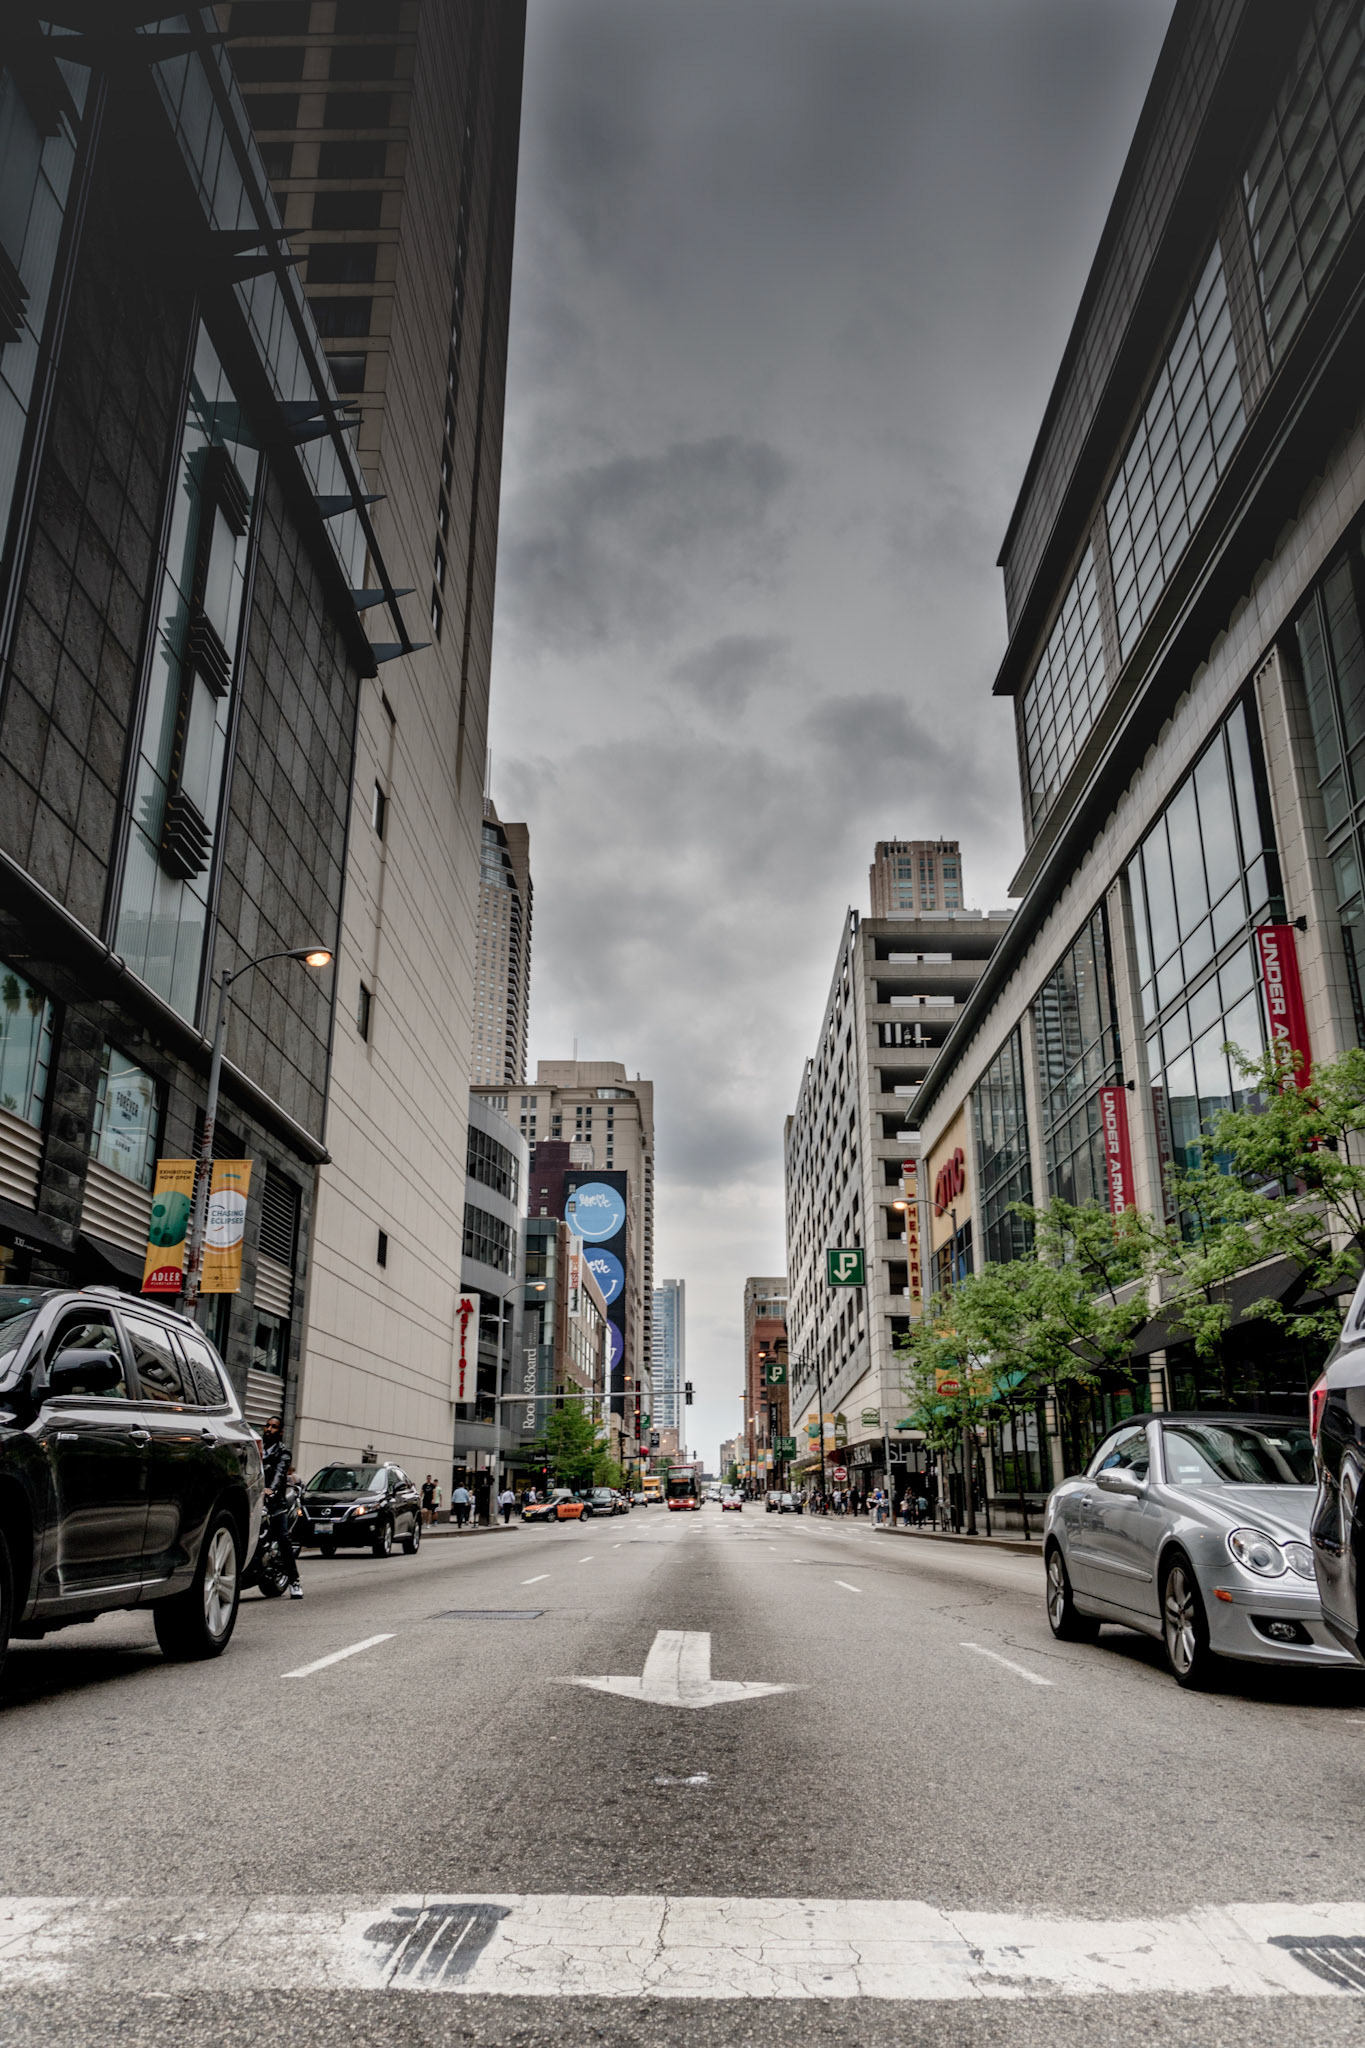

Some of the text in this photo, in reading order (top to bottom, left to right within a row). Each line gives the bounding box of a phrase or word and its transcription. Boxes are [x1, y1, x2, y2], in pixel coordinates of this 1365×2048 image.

[1261, 932, 1287, 1016] UNDER
[116, 1091, 139, 1117] FOREVER
[1103, 1092, 1120, 1154] UNDER
[935, 1147, 965, 1217] amc
[151, 1272, 181, 1281] ADLER
[907, 1194, 920, 1297] HEATRES
[456, 1298, 474, 1398] Marriott
